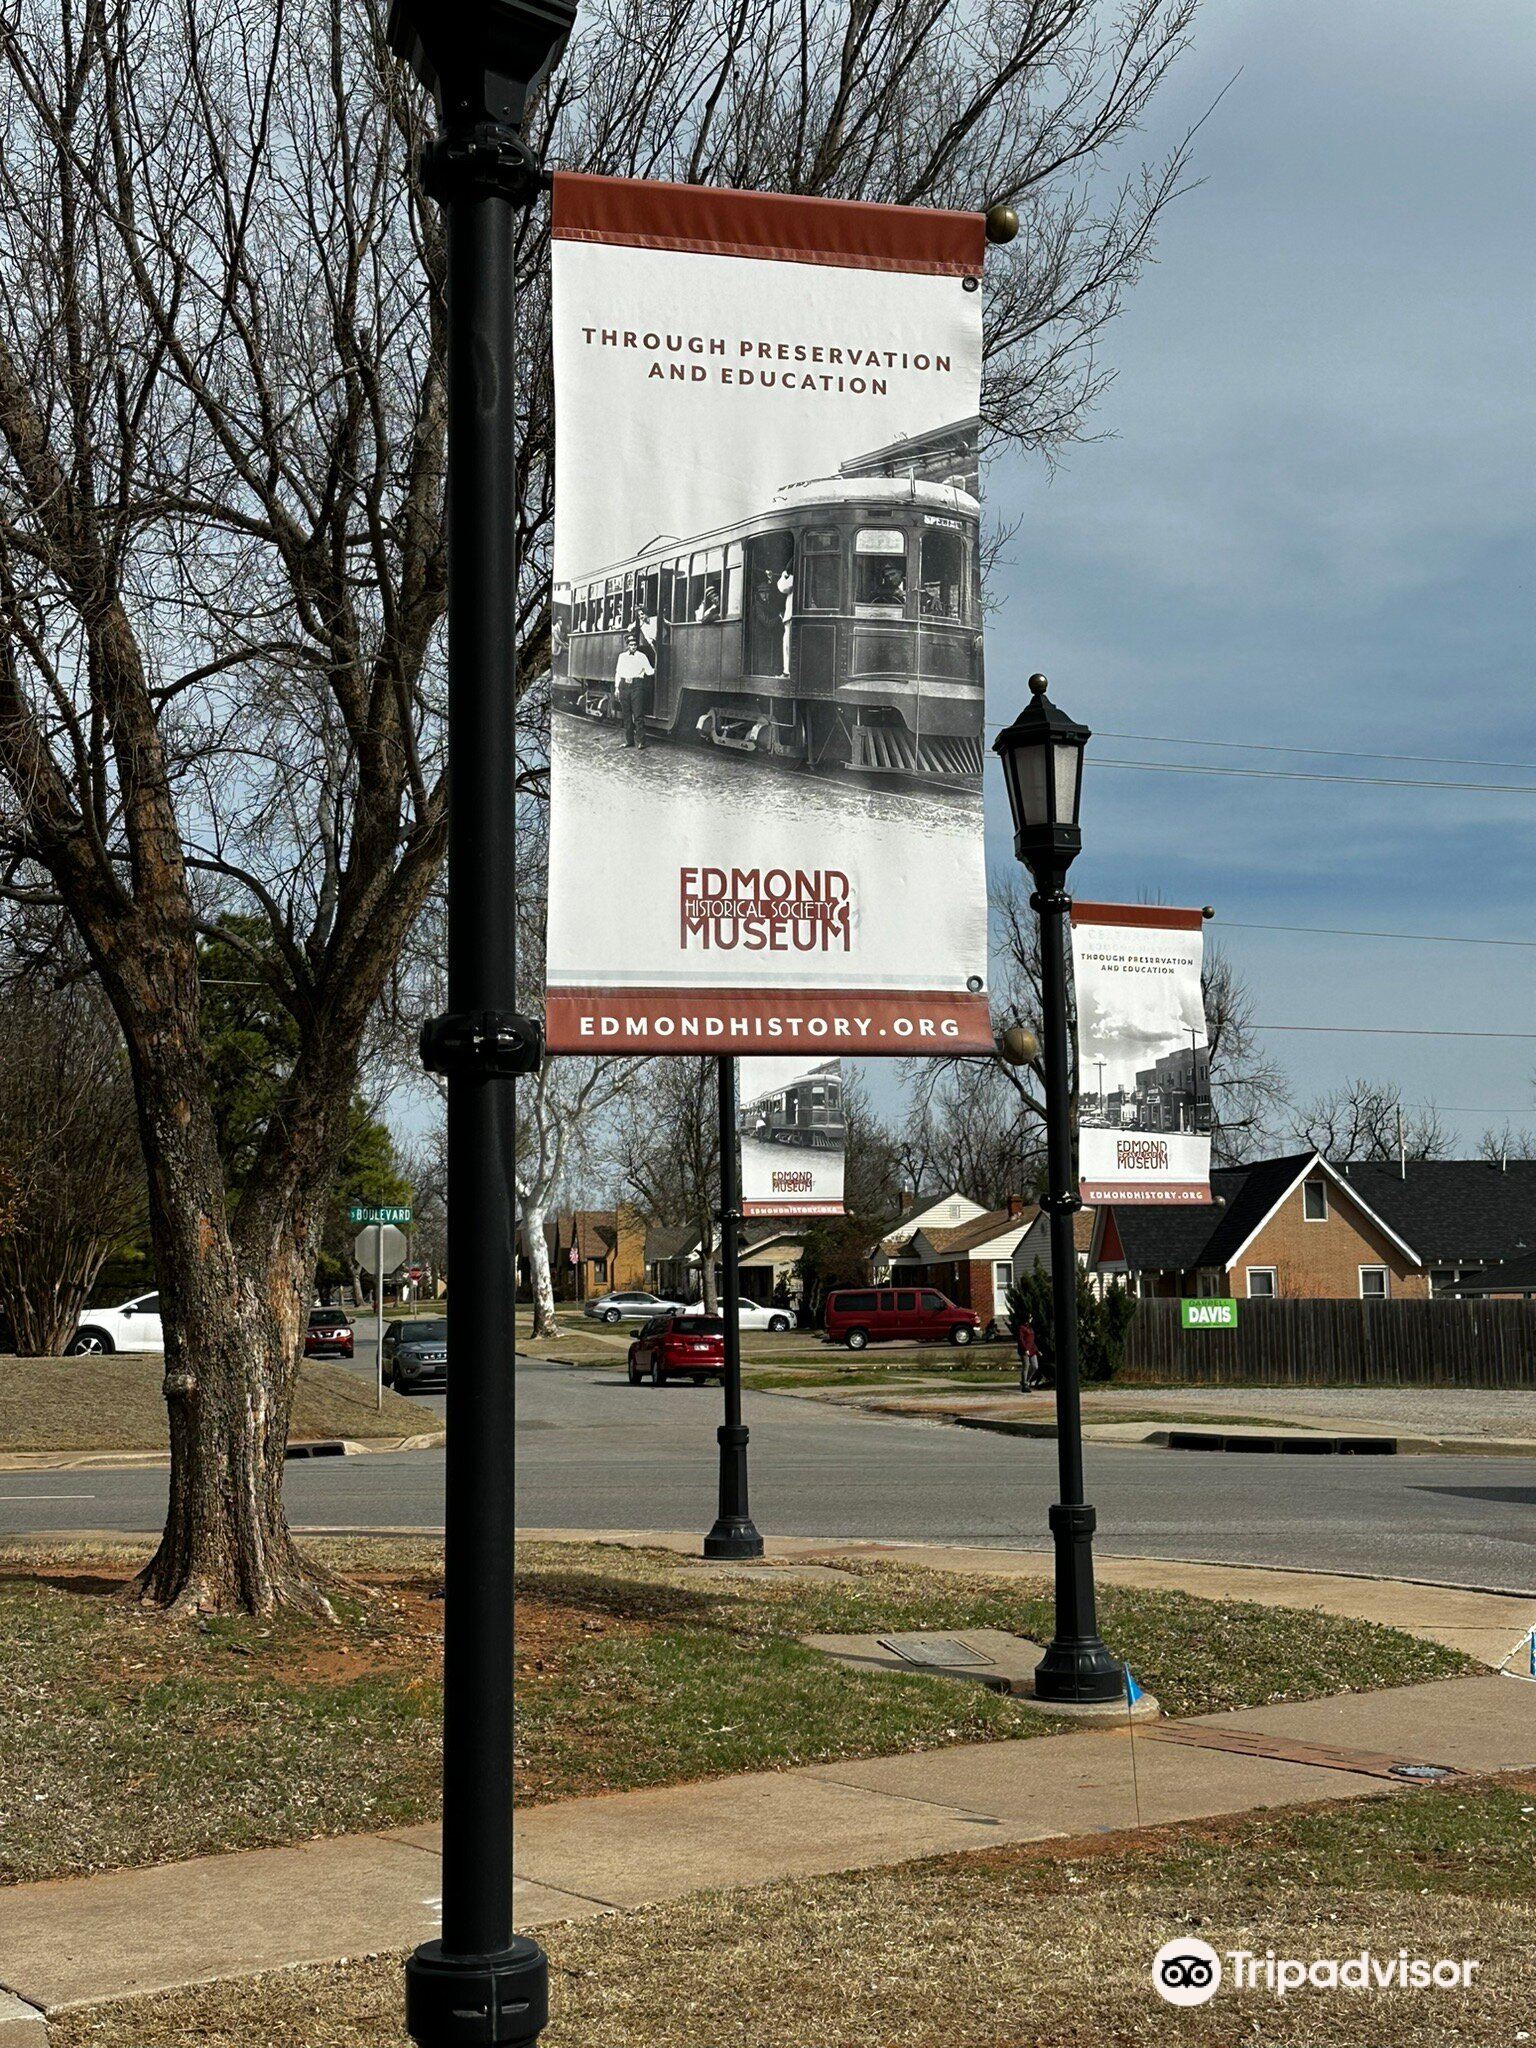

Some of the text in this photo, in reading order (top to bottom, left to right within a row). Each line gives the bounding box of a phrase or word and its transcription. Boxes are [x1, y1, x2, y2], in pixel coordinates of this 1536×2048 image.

[582, 327, 952, 372] THROUGH PRESERVATION
[648, 362, 888, 395] AND EDUCATION
[680, 867, 850, 901] EDMOND
[684, 900, 766, 918] HISTORICAL
[770, 901, 834, 919] SOCIETY
[680, 917, 850, 952] MUSEUM
[1127, 956, 1194, 966] PRESERVATION
[1100, 964, 1175, 974] AND EDUCATION
[580, 1016, 960, 1037] EDMONDHISTORY.ORG
[1116, 1140, 1168, 1153] EDMOND
[1117, 1156, 1169, 1170] MUSEUM
[772, 1171, 813, 1181] EDMOND
[772, 1181, 813, 1192] MUSEUM
[1089, 1191, 1204, 1200] EDMONDHISTORY.ORG
[356, 1208, 411, 1221] BOULEVARD
[1188, 1305, 1232, 1323] DAVIS
